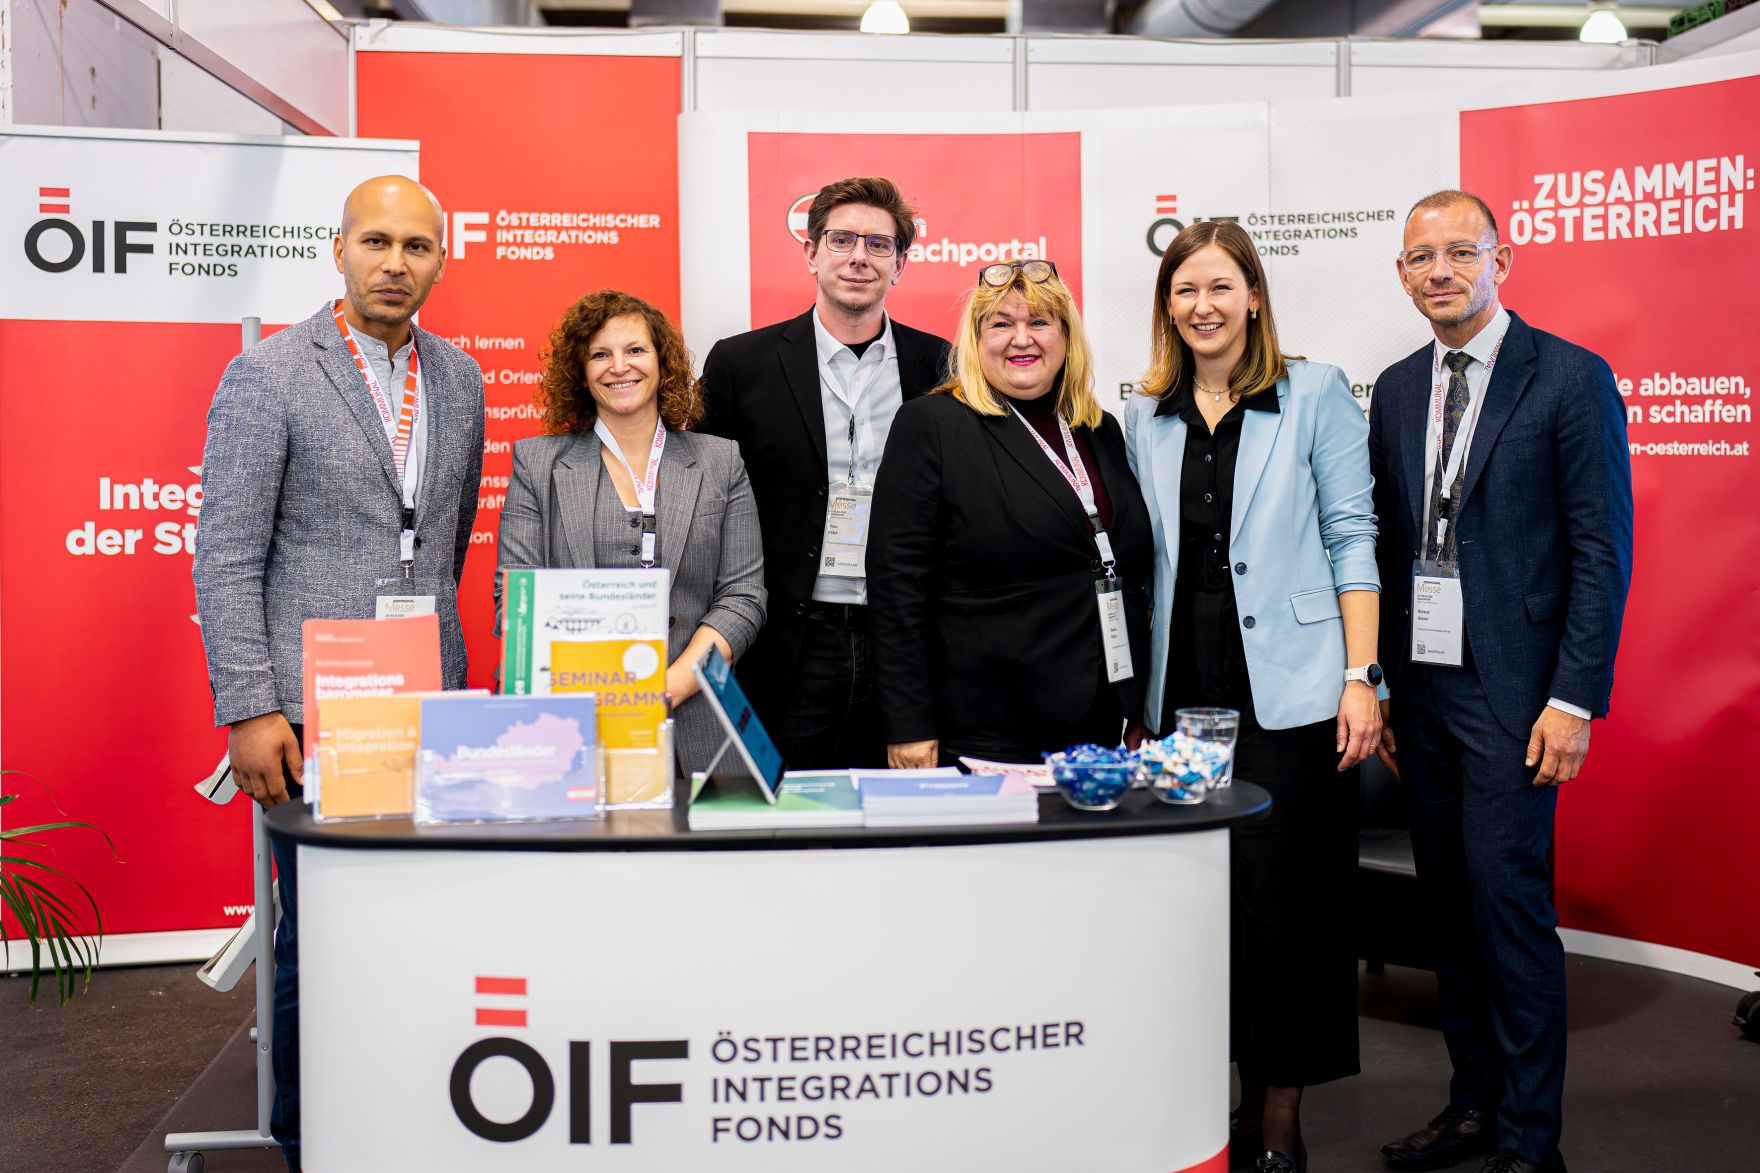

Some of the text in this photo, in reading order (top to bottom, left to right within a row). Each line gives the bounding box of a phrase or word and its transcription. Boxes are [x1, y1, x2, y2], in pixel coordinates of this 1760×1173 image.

[1534, 155, 1754, 208] ZUSAMMEN:
[496, 210, 660, 228] ÖSTERREICHISCHER
[1247, 210, 1395, 226] ÖSTERREICHISCHER
[1510, 192, 1743, 245] ÖSTERREICH
[24, 187, 158, 273] ÖIF
[168, 219, 341, 240] ÖSTERREICHISCH
[496, 229, 619, 244] INTEGRATIONS
[1249, 228, 1358, 241] NTEGRATIONS
[168, 243, 317, 259] INTEGRATIONS
[496, 246, 554, 260] FONDS
[907, 236, 1047, 267] achportal
[1257, 245, 1299, 257] ONDS
[168, 262, 238, 277] FONDS
[475, 335, 524, 349] lernen
[1639, 372, 1751, 398] abbauen,
[372, 379, 391, 422] KOMMUNAL
[1434, 384, 1443, 423] KOMMUNAL
[1649, 399, 1751, 423] schaffen
[99, 477, 204, 517] Integ
[66, 521, 197, 555] der St
[1417, 583, 1442, 594] Messe
[385, 602, 415, 612] Messe
[315, 673, 405, 688] Integrations
[550, 671, 637, 686] SEMINAR
[711, 1021, 1086, 1063] ÖSTERREICHISCHER
[449, 976, 689, 1144] ÖIF
[711, 1067, 994, 1104] INTEGRATIONS
[711, 1114, 844, 1143] FONDS
